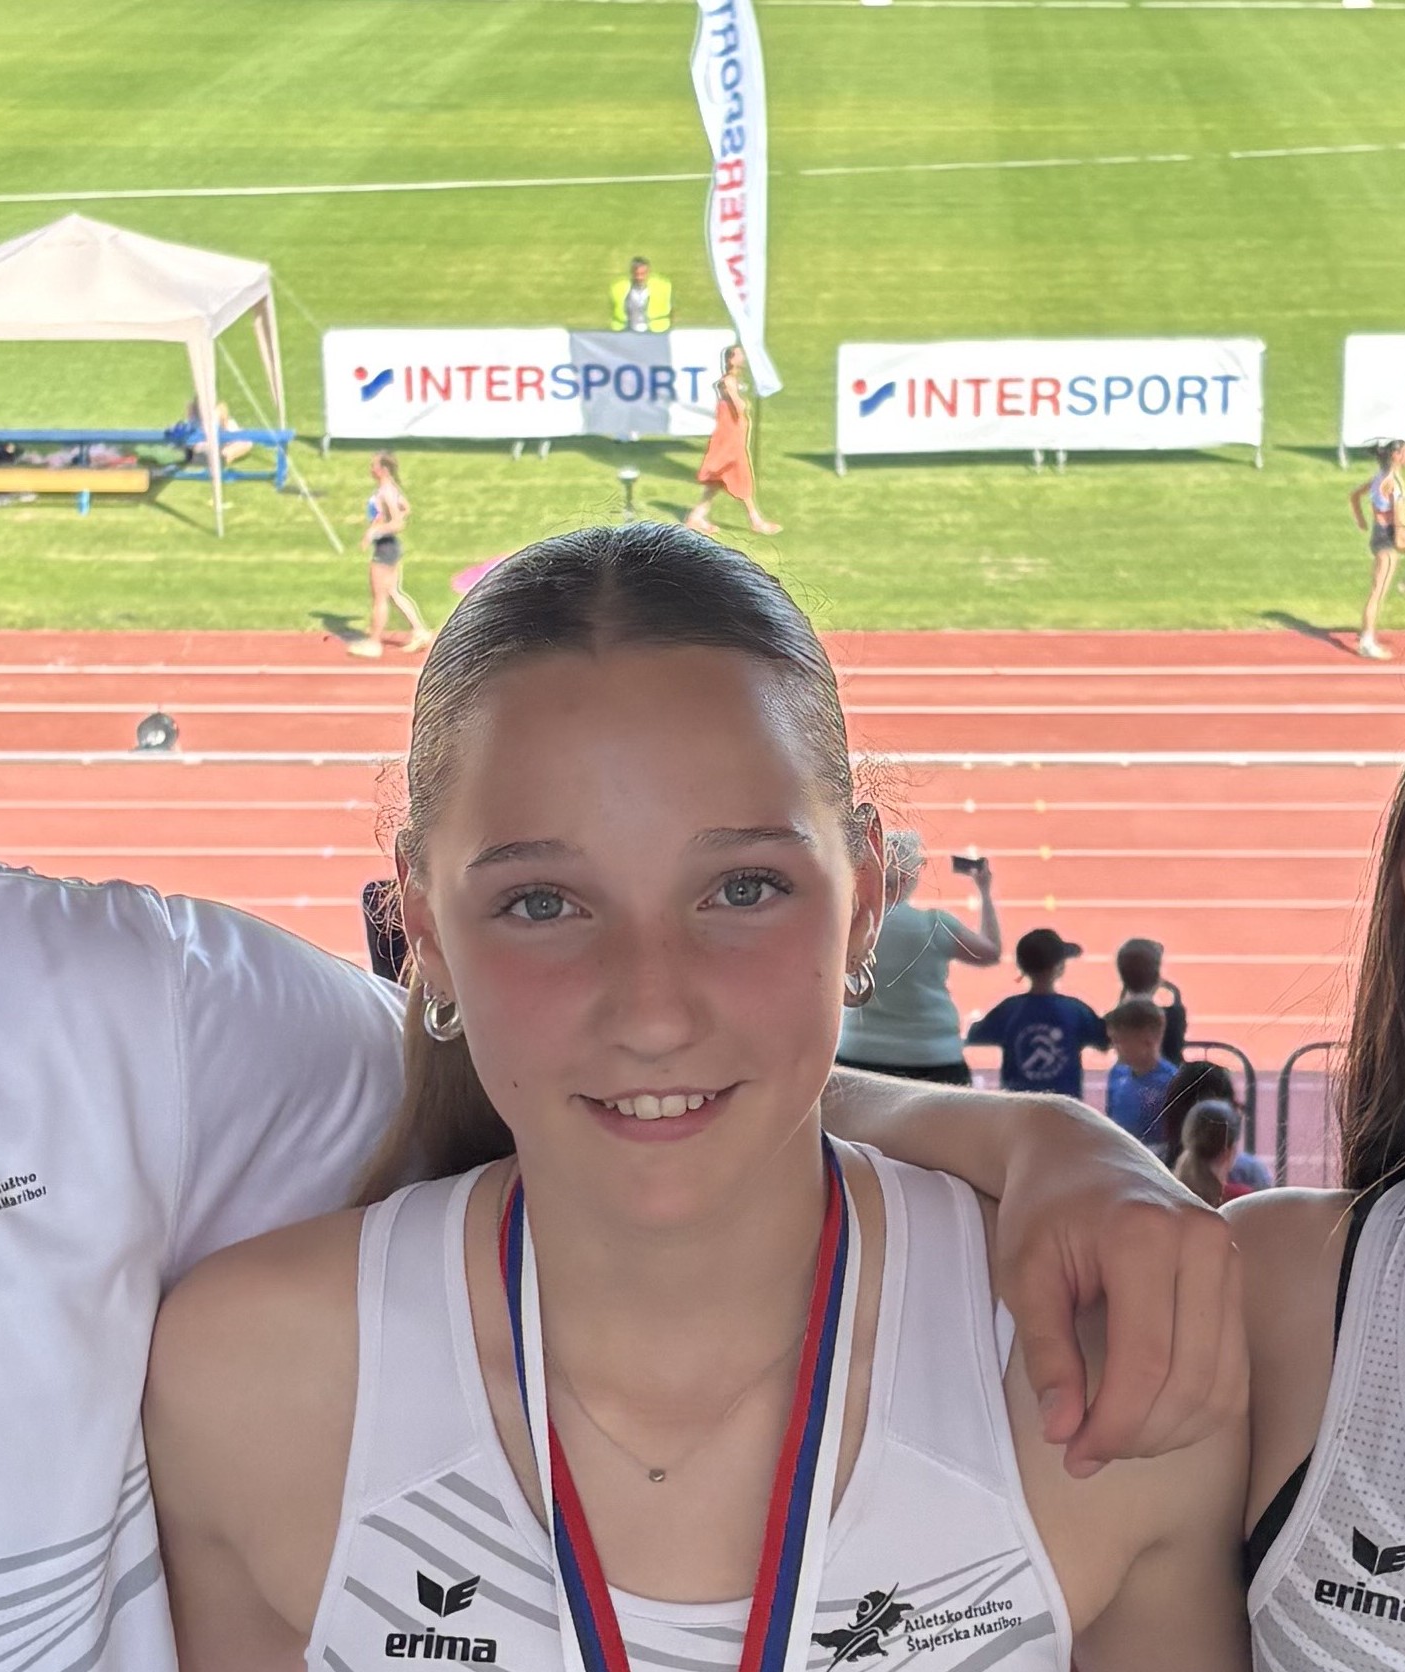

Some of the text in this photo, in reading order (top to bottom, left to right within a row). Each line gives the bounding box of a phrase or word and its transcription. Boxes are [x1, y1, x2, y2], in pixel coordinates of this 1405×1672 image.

[404, 363, 708, 403] INTERSPORT
[907, 374, 1241, 418] INTERSPORT
[904, 1600, 1013, 1633] Atletsko društvo
[906, 1616, 1023, 1652] Štajerska Maribor
[385, 1627, 497, 1663] erima
